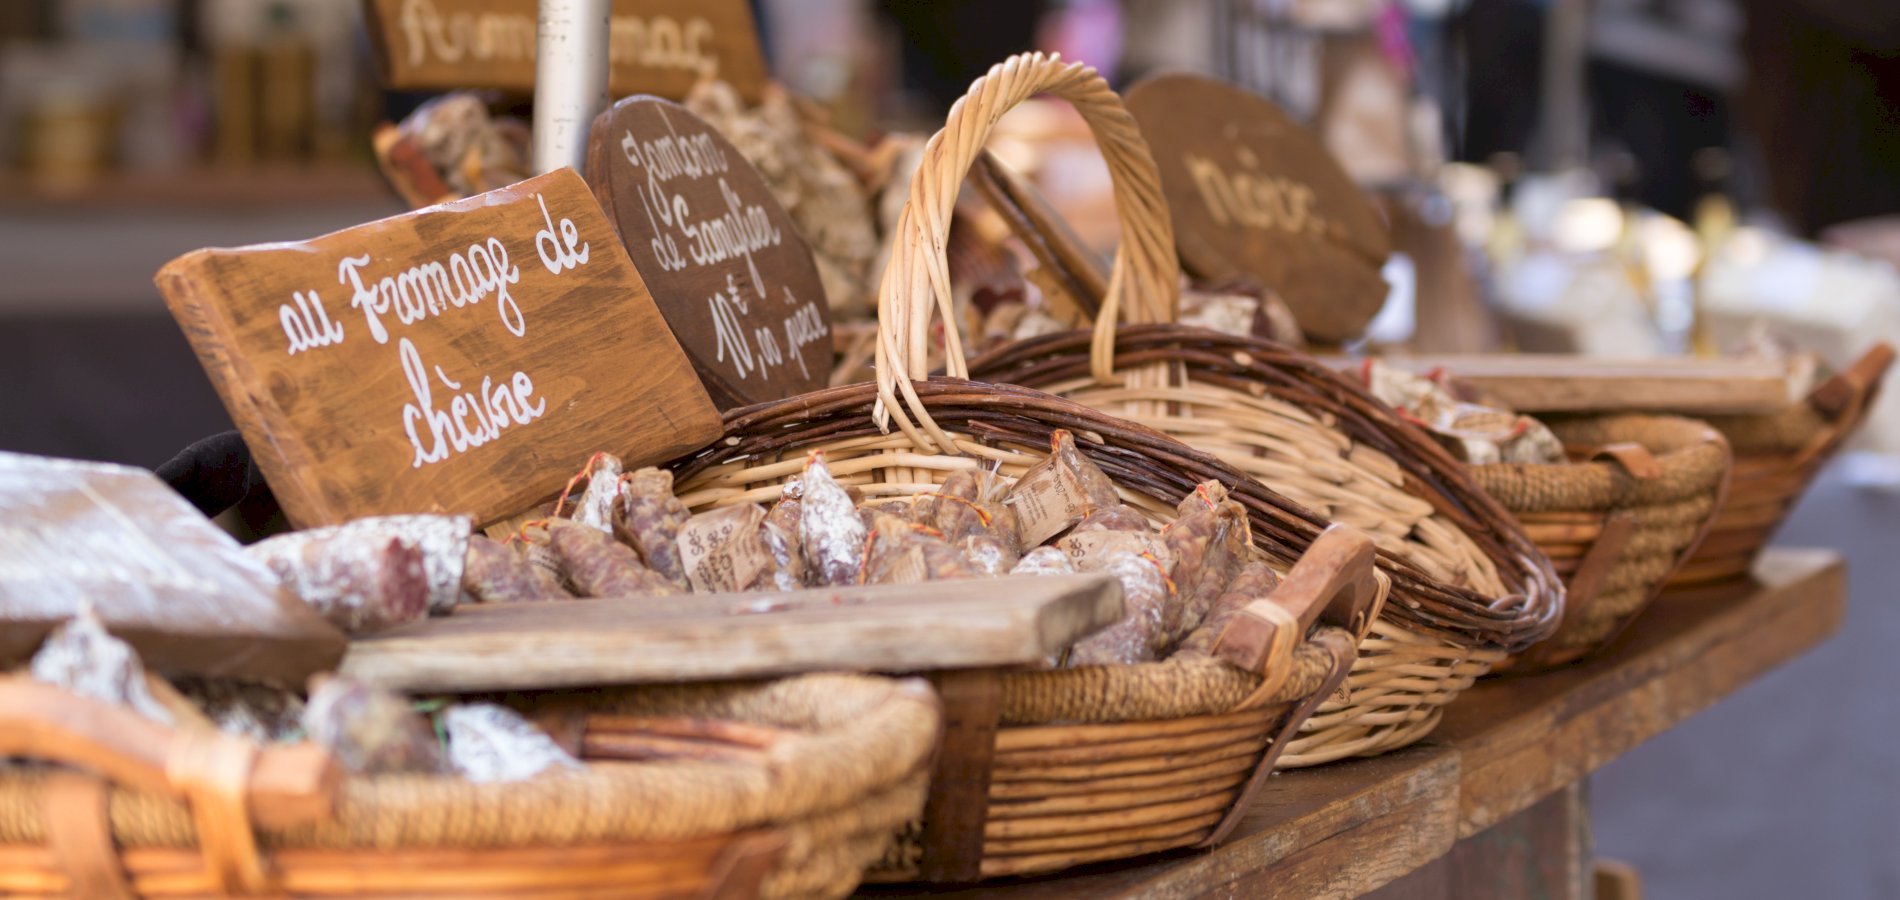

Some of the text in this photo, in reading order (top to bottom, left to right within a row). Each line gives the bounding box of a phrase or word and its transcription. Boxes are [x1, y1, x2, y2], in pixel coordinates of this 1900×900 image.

[622, 104, 729, 227] Jambon
[637, 184, 686, 272] de
[279, 193, 589, 355] au Fromage de
[399, 337, 546, 468] chèvre
